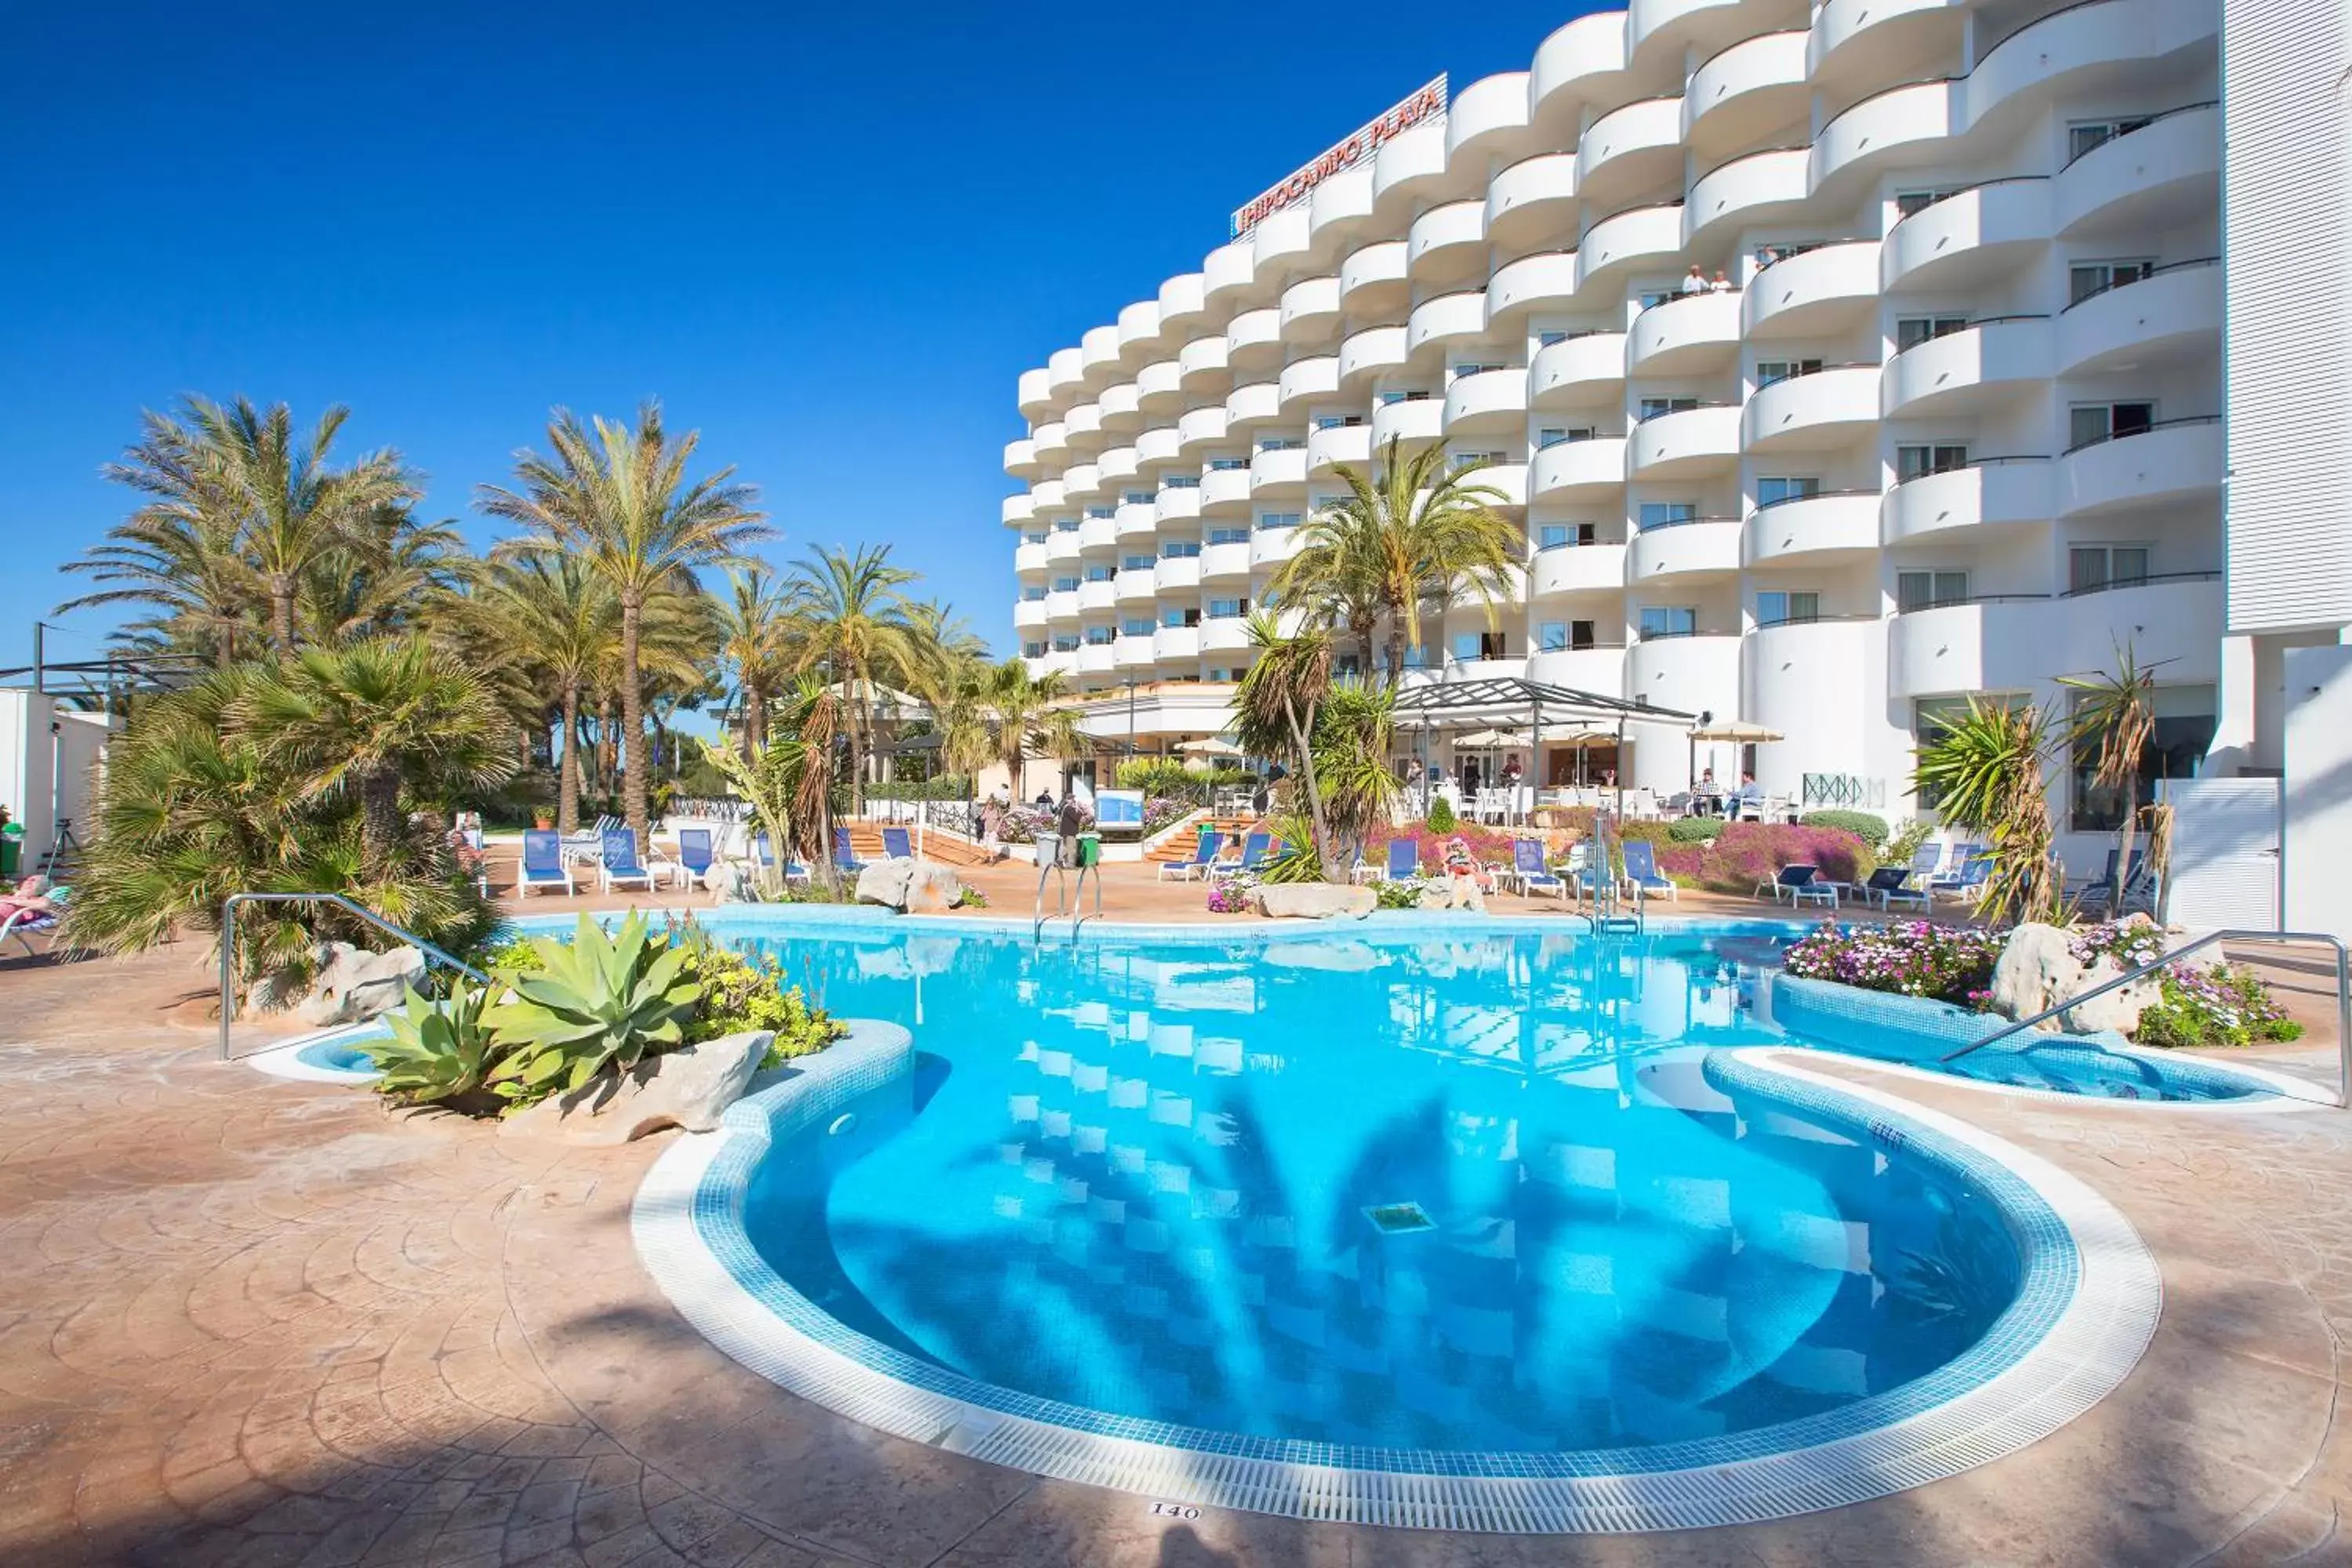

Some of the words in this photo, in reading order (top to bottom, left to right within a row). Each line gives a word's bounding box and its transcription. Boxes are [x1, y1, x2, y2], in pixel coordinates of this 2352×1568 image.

[1243, 137, 1362, 228] HIPOCAMPO
[1370, 89, 1439, 148] PLAYA
[1153, 1503, 1199, 1520] 140
